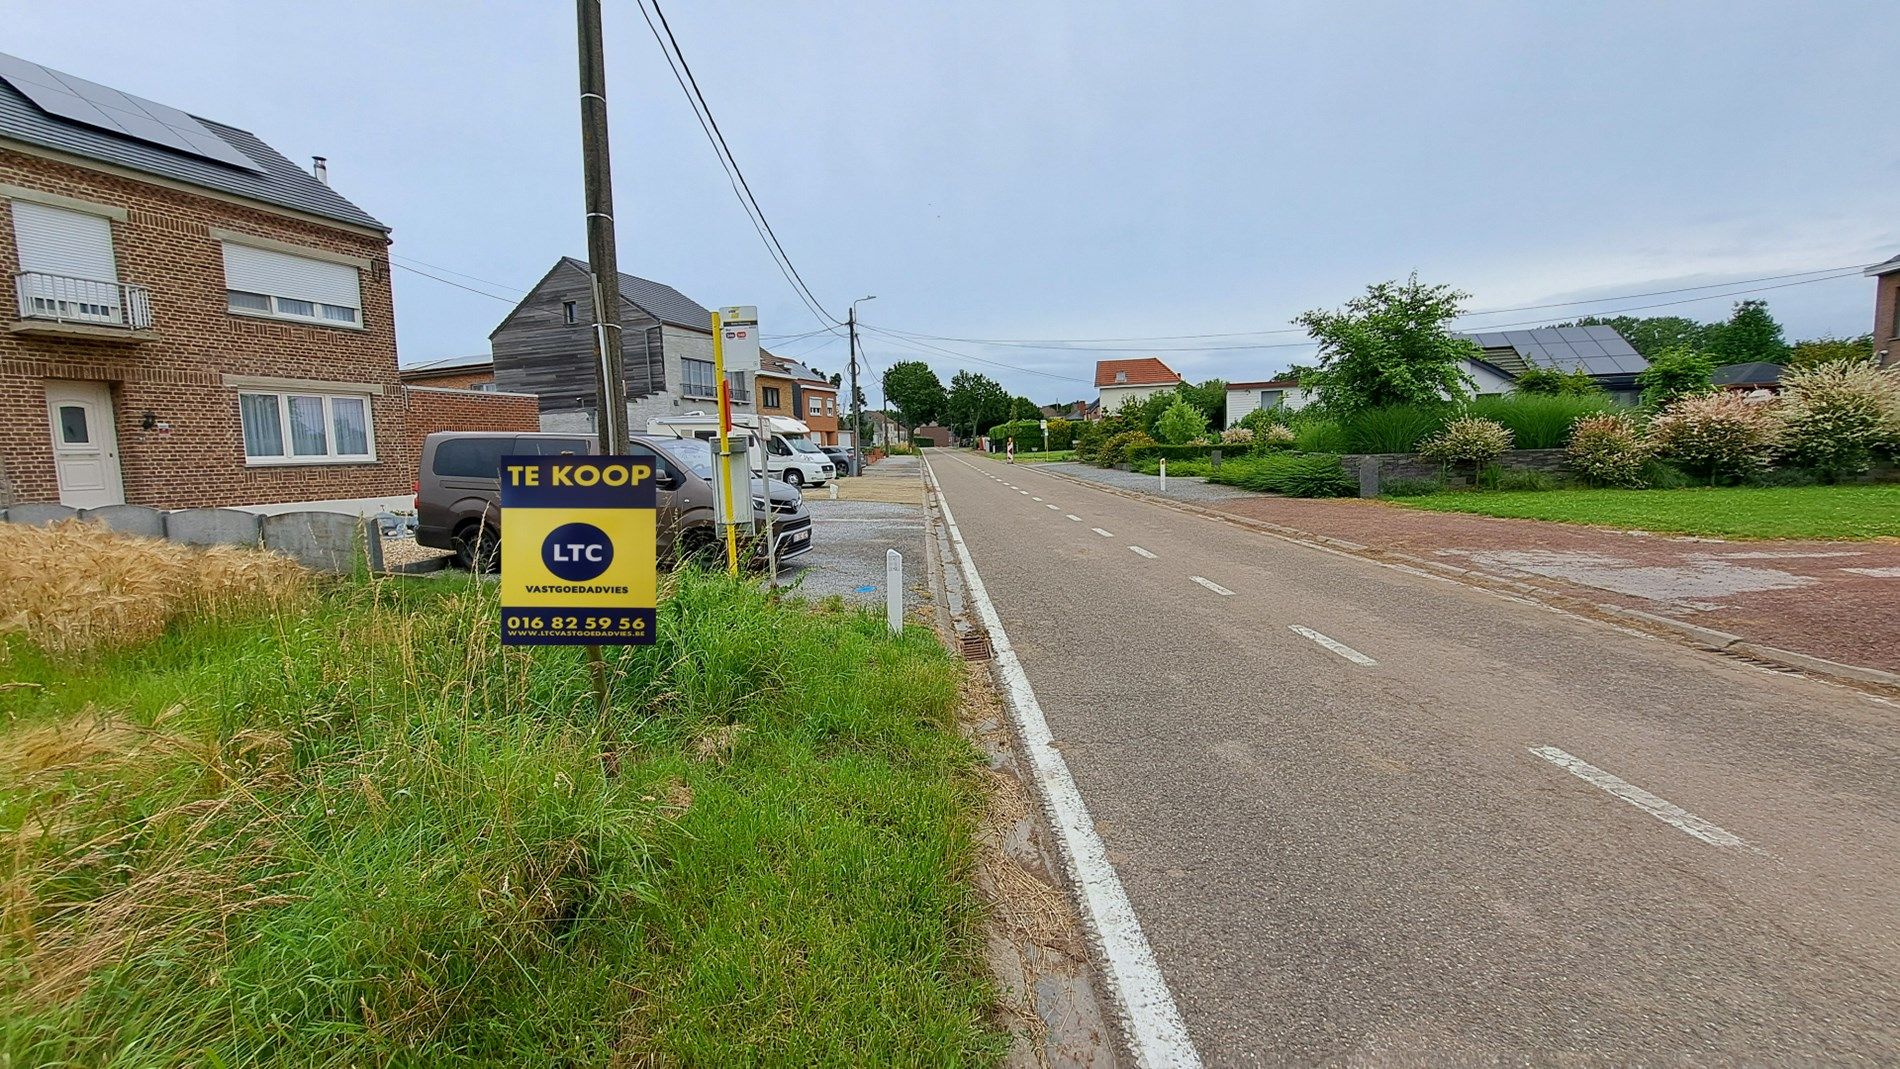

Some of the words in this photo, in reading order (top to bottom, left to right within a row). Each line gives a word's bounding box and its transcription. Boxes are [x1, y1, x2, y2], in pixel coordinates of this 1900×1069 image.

[507, 465, 540, 487] TE
[552, 464, 651, 487] KOOP
[553, 543, 603, 562] LTC
[525, 585, 629, 594] VASTGOEDADVIES
[507, 616, 544, 630] 016
[551, 616, 578, 630] 82
[584, 617, 612, 630] 59
[618, 617, 646, 630] 56
